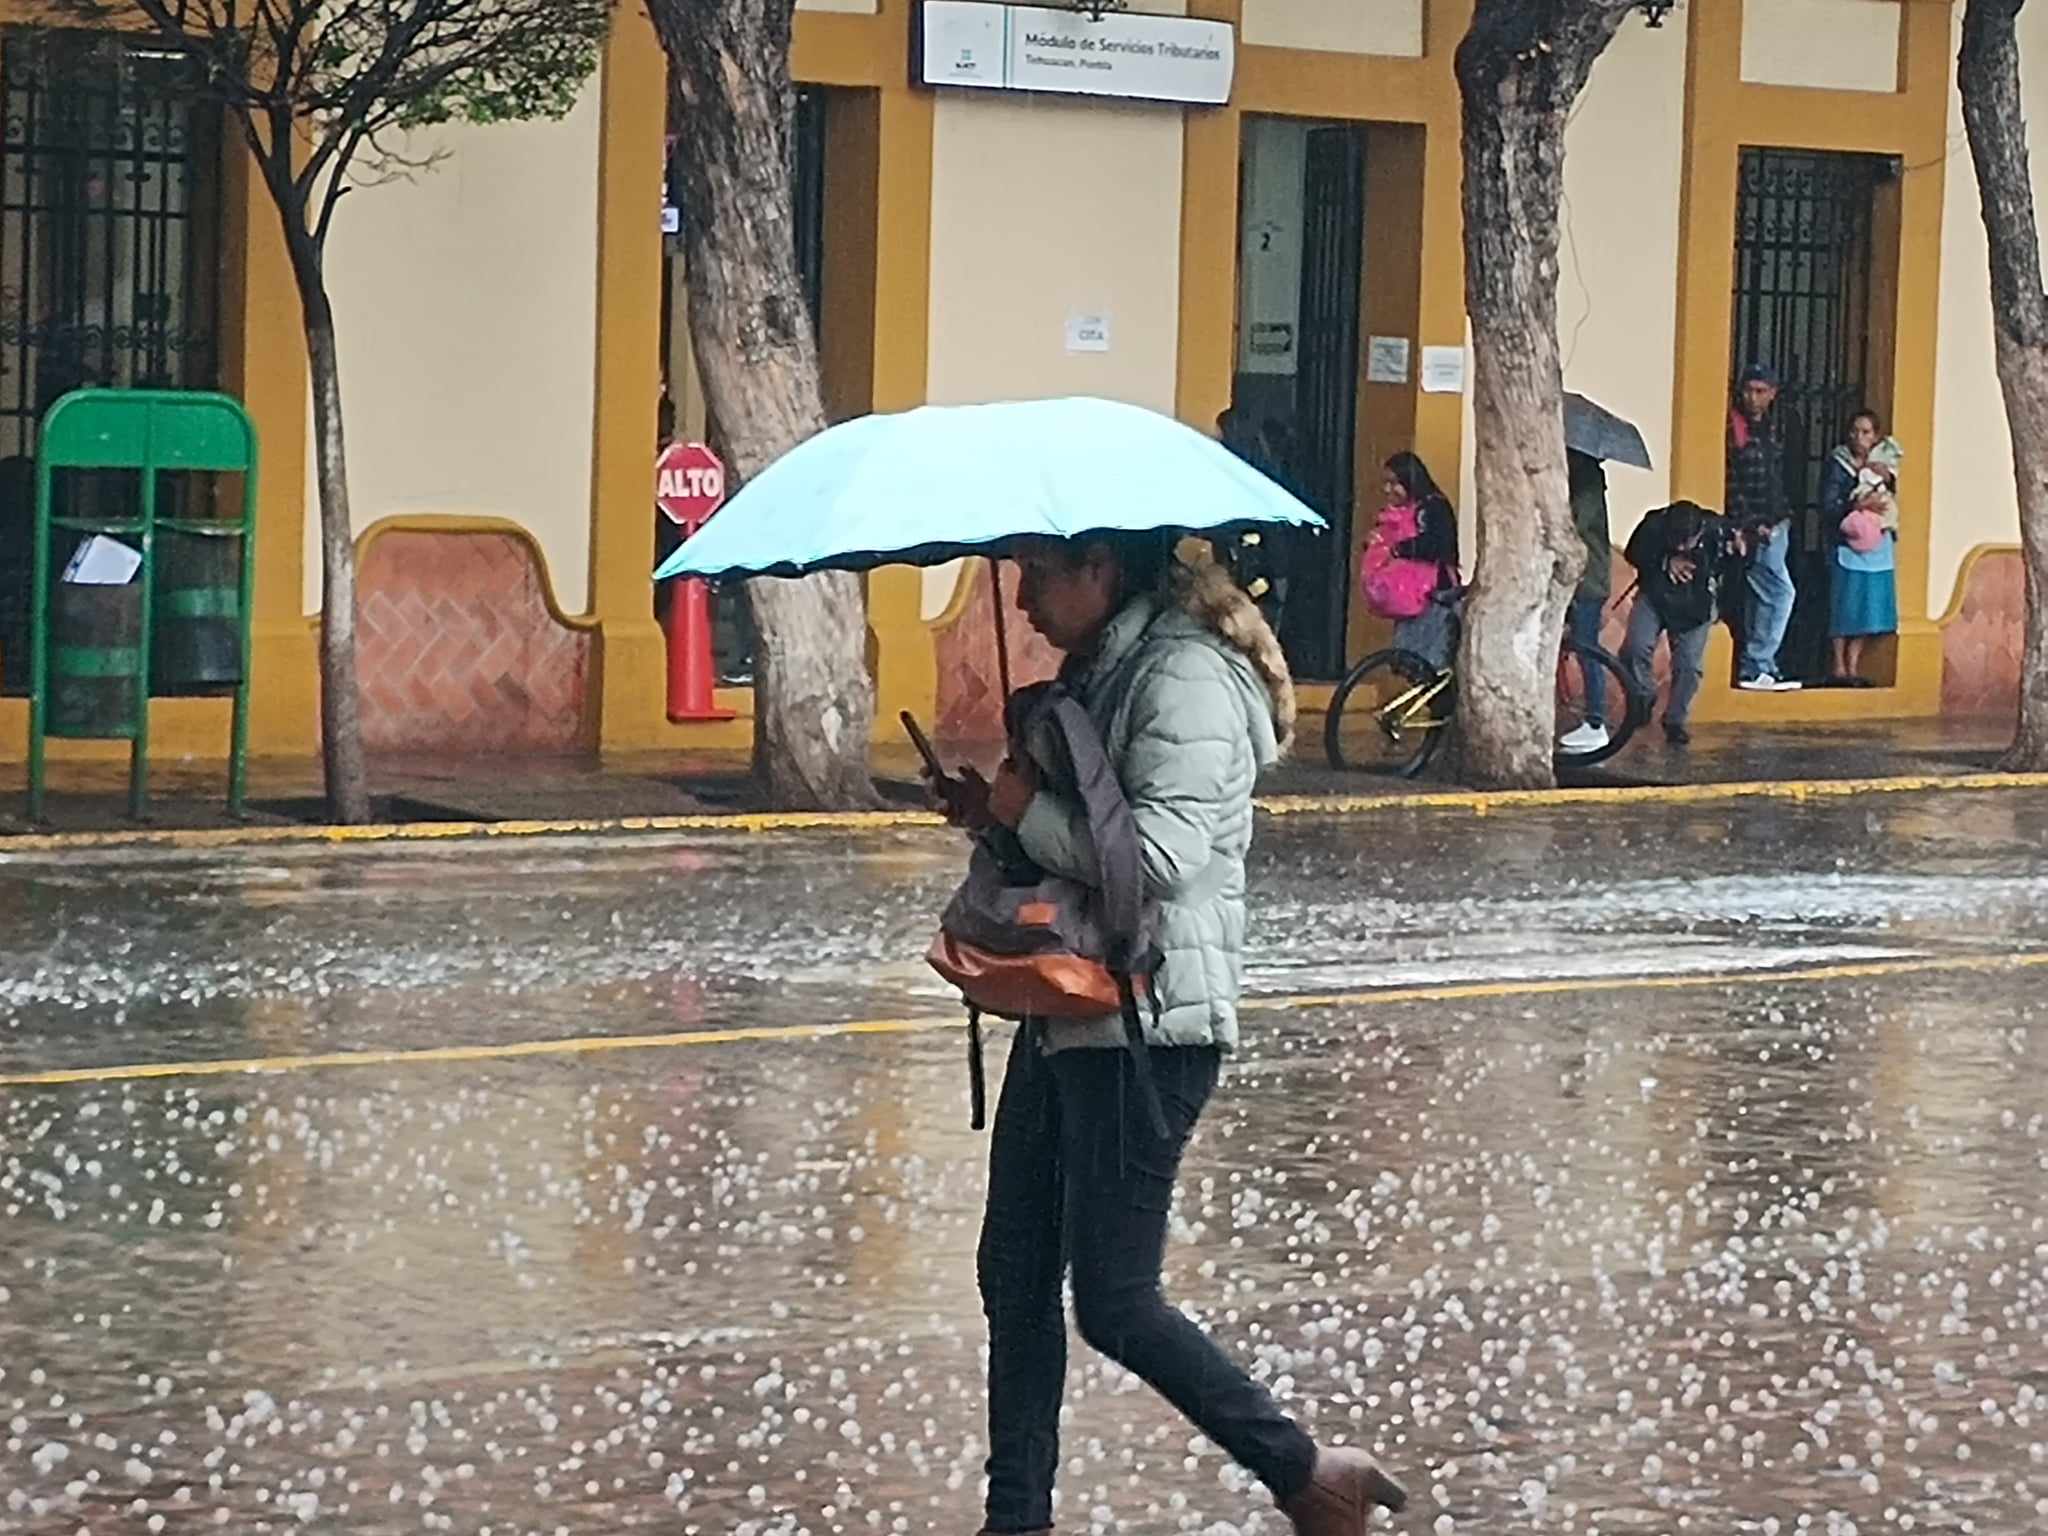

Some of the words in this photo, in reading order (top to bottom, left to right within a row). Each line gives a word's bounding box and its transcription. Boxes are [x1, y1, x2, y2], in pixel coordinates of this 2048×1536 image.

[1025, 32, 1076, 49] Módulo
[1080, 37, 1095, 51] de
[1100, 38, 1153, 55] Servicios
[1158, 42, 1220, 60] Tributarios
[658, 469, 720, 498] ALTO
